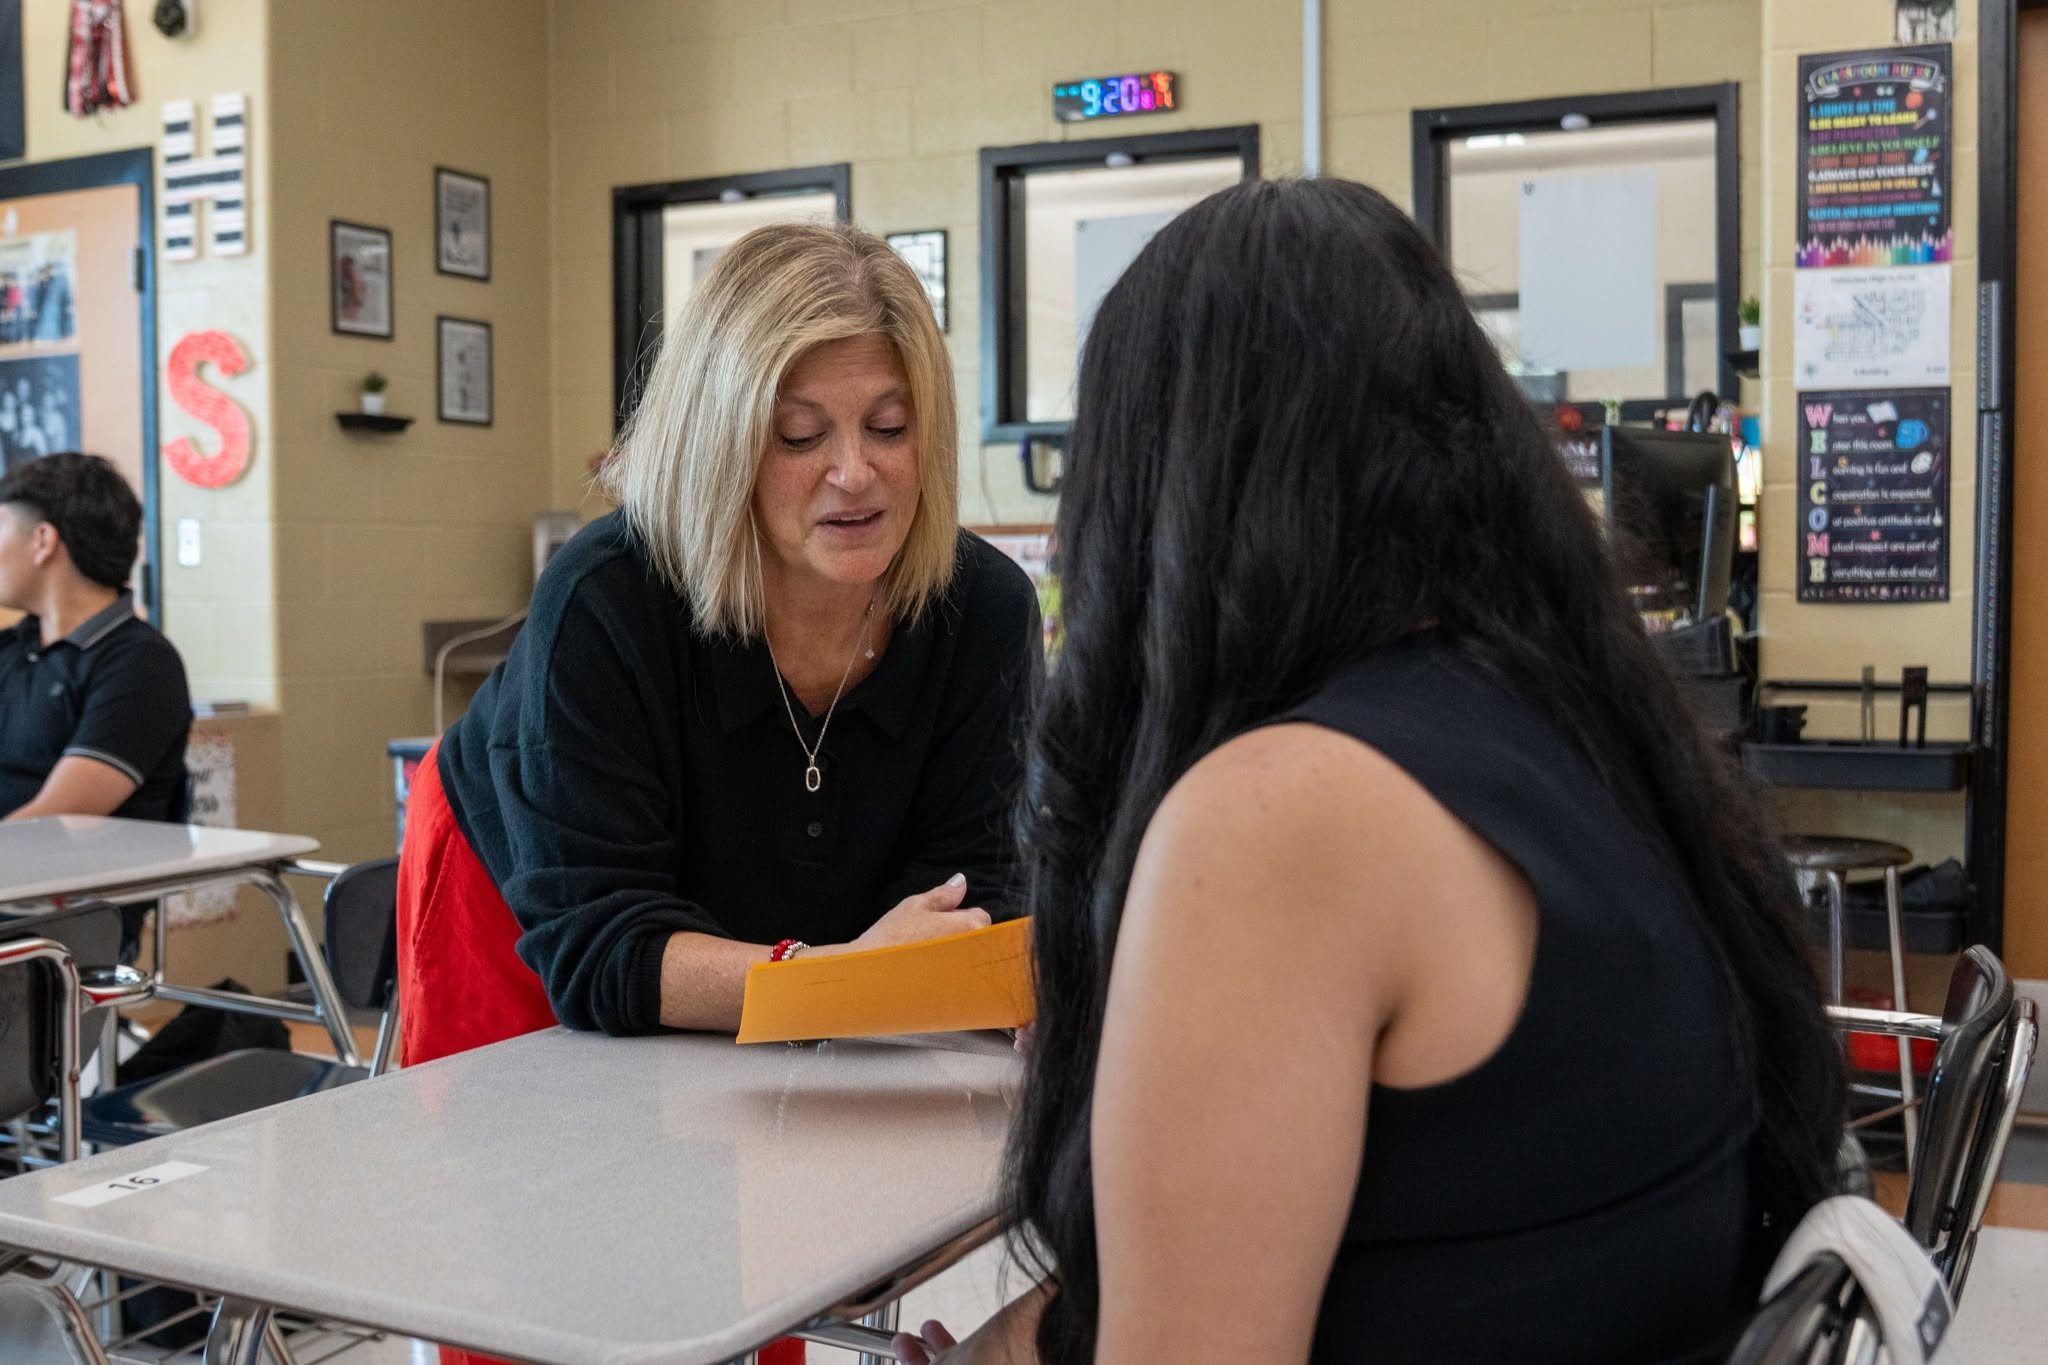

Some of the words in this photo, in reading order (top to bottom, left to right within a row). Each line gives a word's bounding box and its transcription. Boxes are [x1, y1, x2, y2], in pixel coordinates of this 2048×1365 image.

[1817, 64, 1889, 88] CLASSROOM
[1866, 142, 1880, 152] IN
[1882, 136, 1939, 151] YOURSELF
[1858, 168, 1876, 179] DO
[1877, 166, 1905, 178] YOUR
[161, 329, 249, 490] S
[109, 1175, 160, 1191] 16
